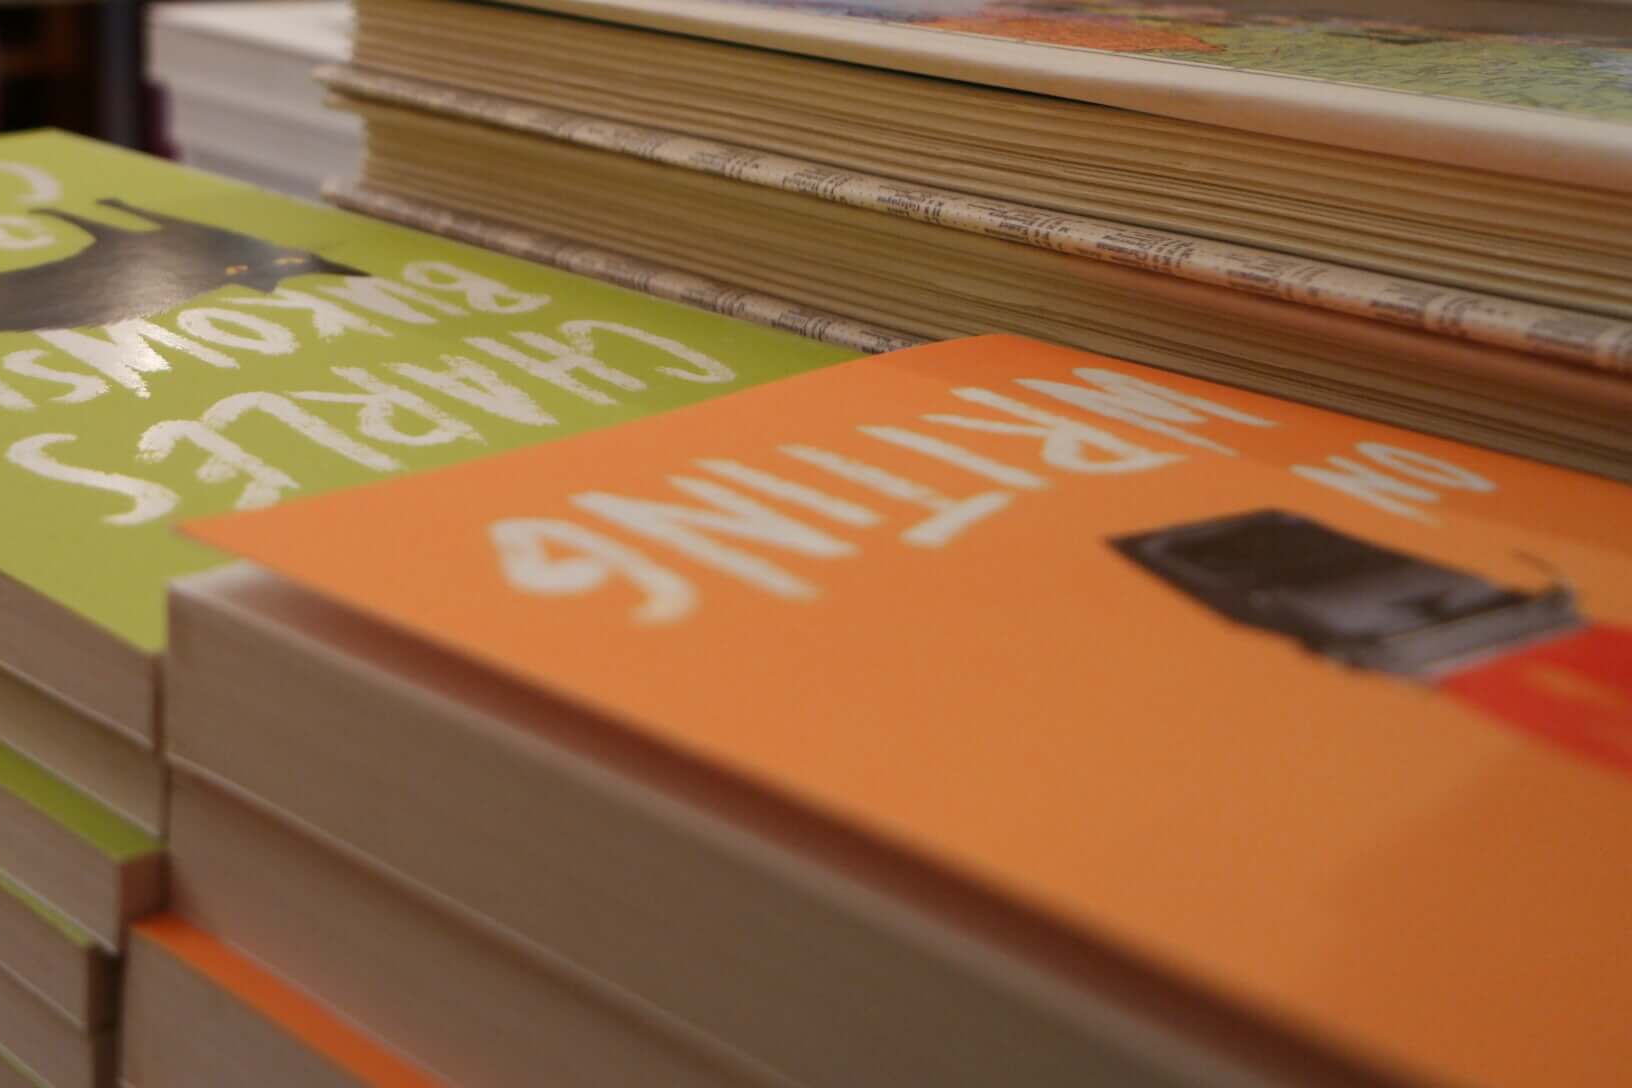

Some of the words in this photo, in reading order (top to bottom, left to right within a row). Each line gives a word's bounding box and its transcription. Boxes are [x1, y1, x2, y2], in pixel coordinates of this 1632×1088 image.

[5, 318, 735, 525] CHARLES
[490, 366, 1278, 624] WRITING
[1290, 441, 1498, 525] ON
